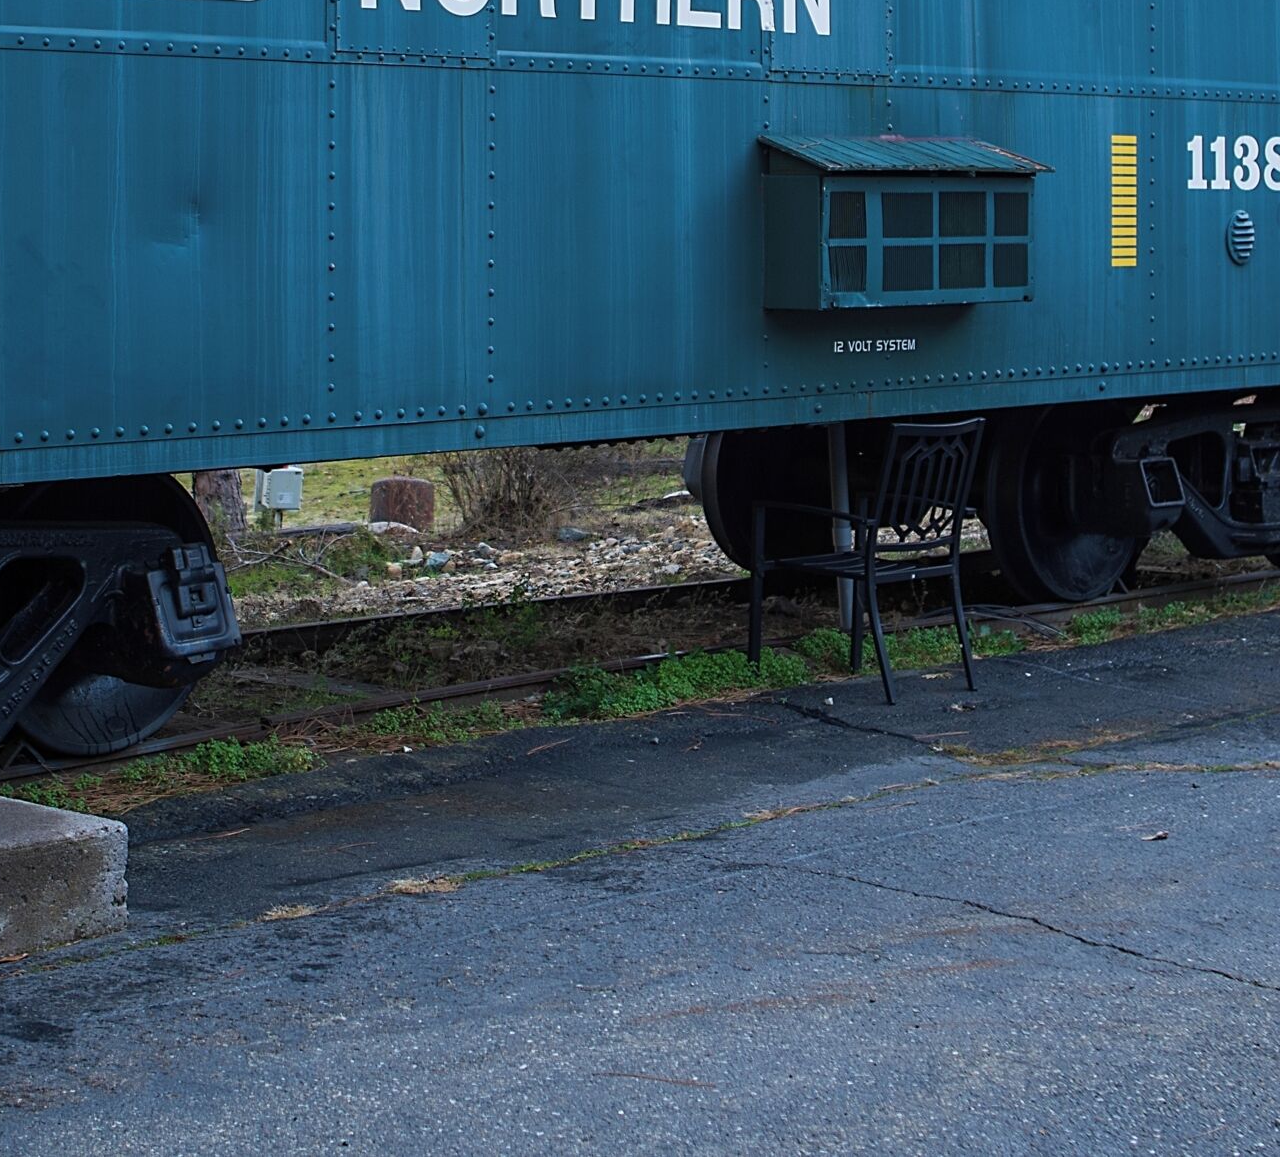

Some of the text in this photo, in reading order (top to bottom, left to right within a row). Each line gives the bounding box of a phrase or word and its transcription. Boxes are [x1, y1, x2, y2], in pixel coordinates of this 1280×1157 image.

[833, 338, 916, 354] 12 VOLT SYSTEM
